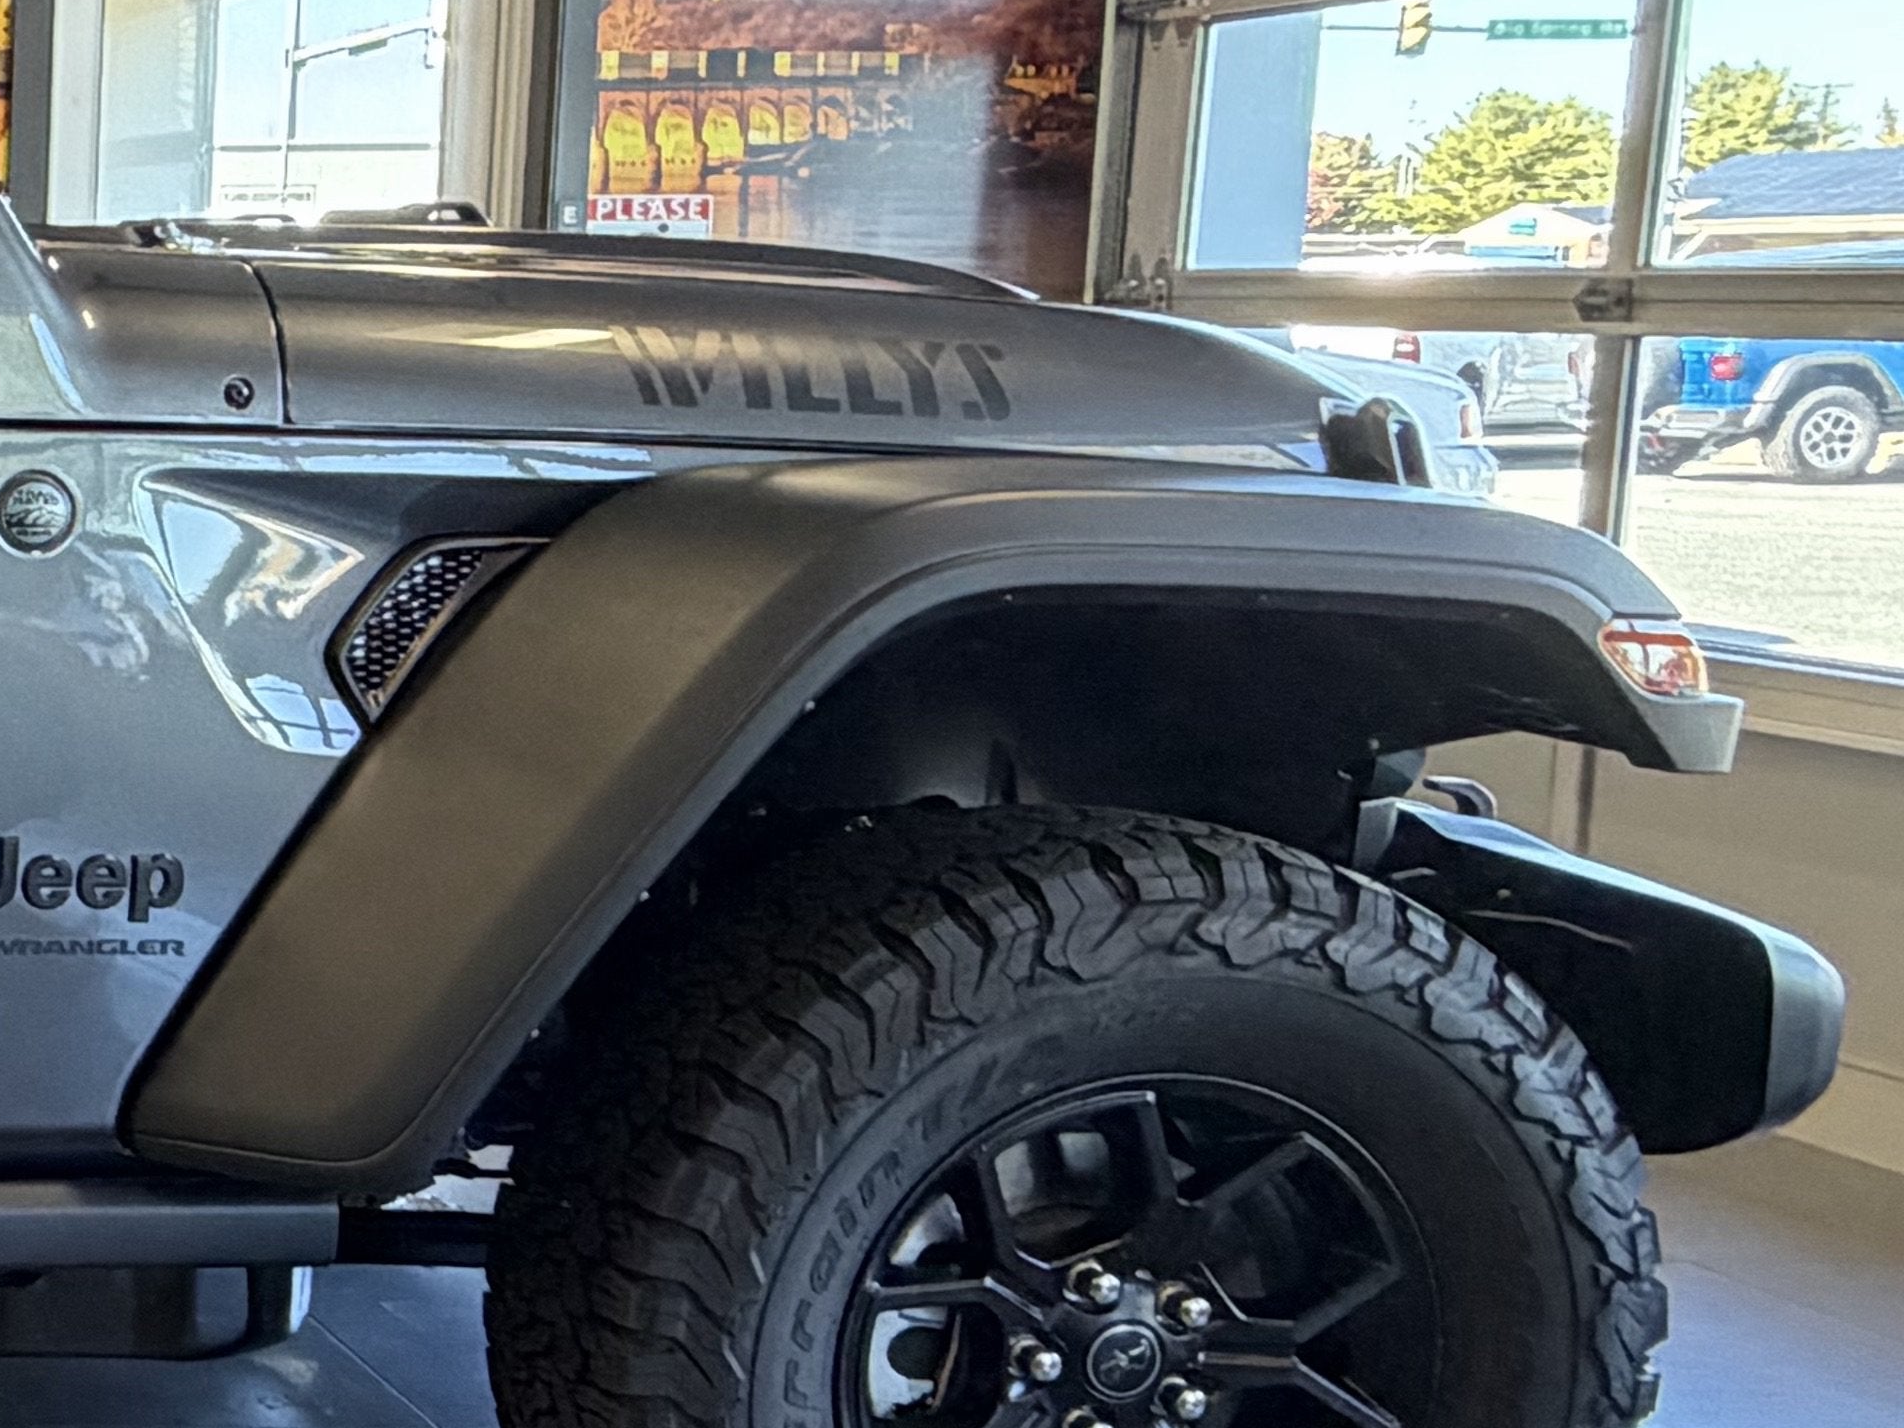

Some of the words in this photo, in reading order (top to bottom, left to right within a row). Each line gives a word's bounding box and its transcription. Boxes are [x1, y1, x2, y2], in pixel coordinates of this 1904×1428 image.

[563, 205, 578, 225] E
[595, 198, 703, 221] PLEASE
[608, 324, 1011, 421] WILLYS
